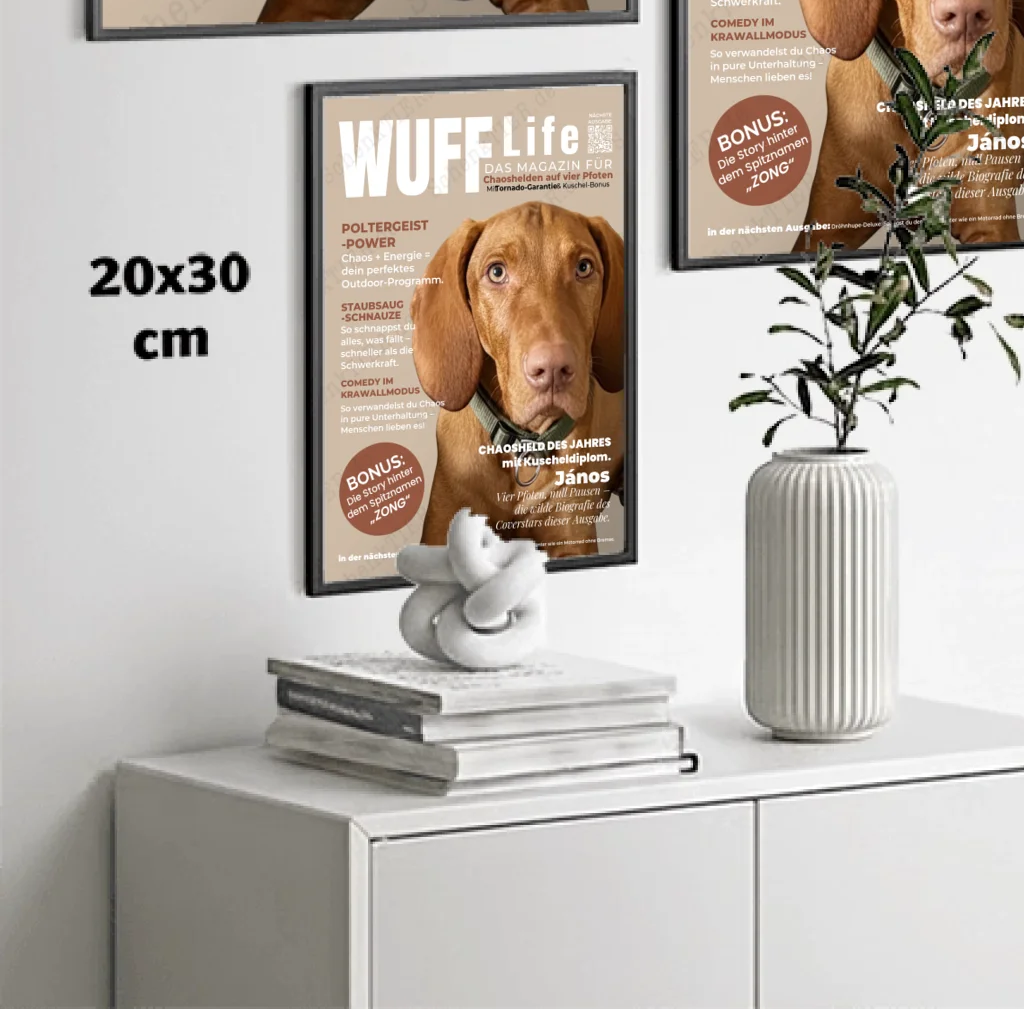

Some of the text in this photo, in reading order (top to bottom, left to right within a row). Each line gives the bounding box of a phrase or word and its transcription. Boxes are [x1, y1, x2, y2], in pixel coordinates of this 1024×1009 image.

[710, 17, 774, 28] COMEDY IM
[710, 29, 806, 41] KRAWALLMODUS
[717, 110, 788, 152] BONUS:
[717, 124, 797, 169] Die Story hinter
[338, 112, 578, 199] WUFF Life
[718, 136, 808, 185] dem Spitznamen
[484, 156, 612, 174] DAS MAGAZIN FÜR
[483, 170, 613, 184] Chaoshelden auf vier Pfoten
[342, 219, 428, 234] POLTERGEIST
[341, 236, 395, 249] -POWER
[341, 299, 403, 311] STAUBSAUG
[341, 310, 401, 322] -SCHNAUZE
[340, 377, 393, 387] COMEDY IM
[340, 386, 420, 398] KRAWALLMODUS
[478, 437, 611, 455] CHAOSHELD DES JAHRES
[502, 450, 611, 469] mit Kuscheldiplom.
[346, 454, 405, 491] BONUS:
[554, 466, 610, 486] János
